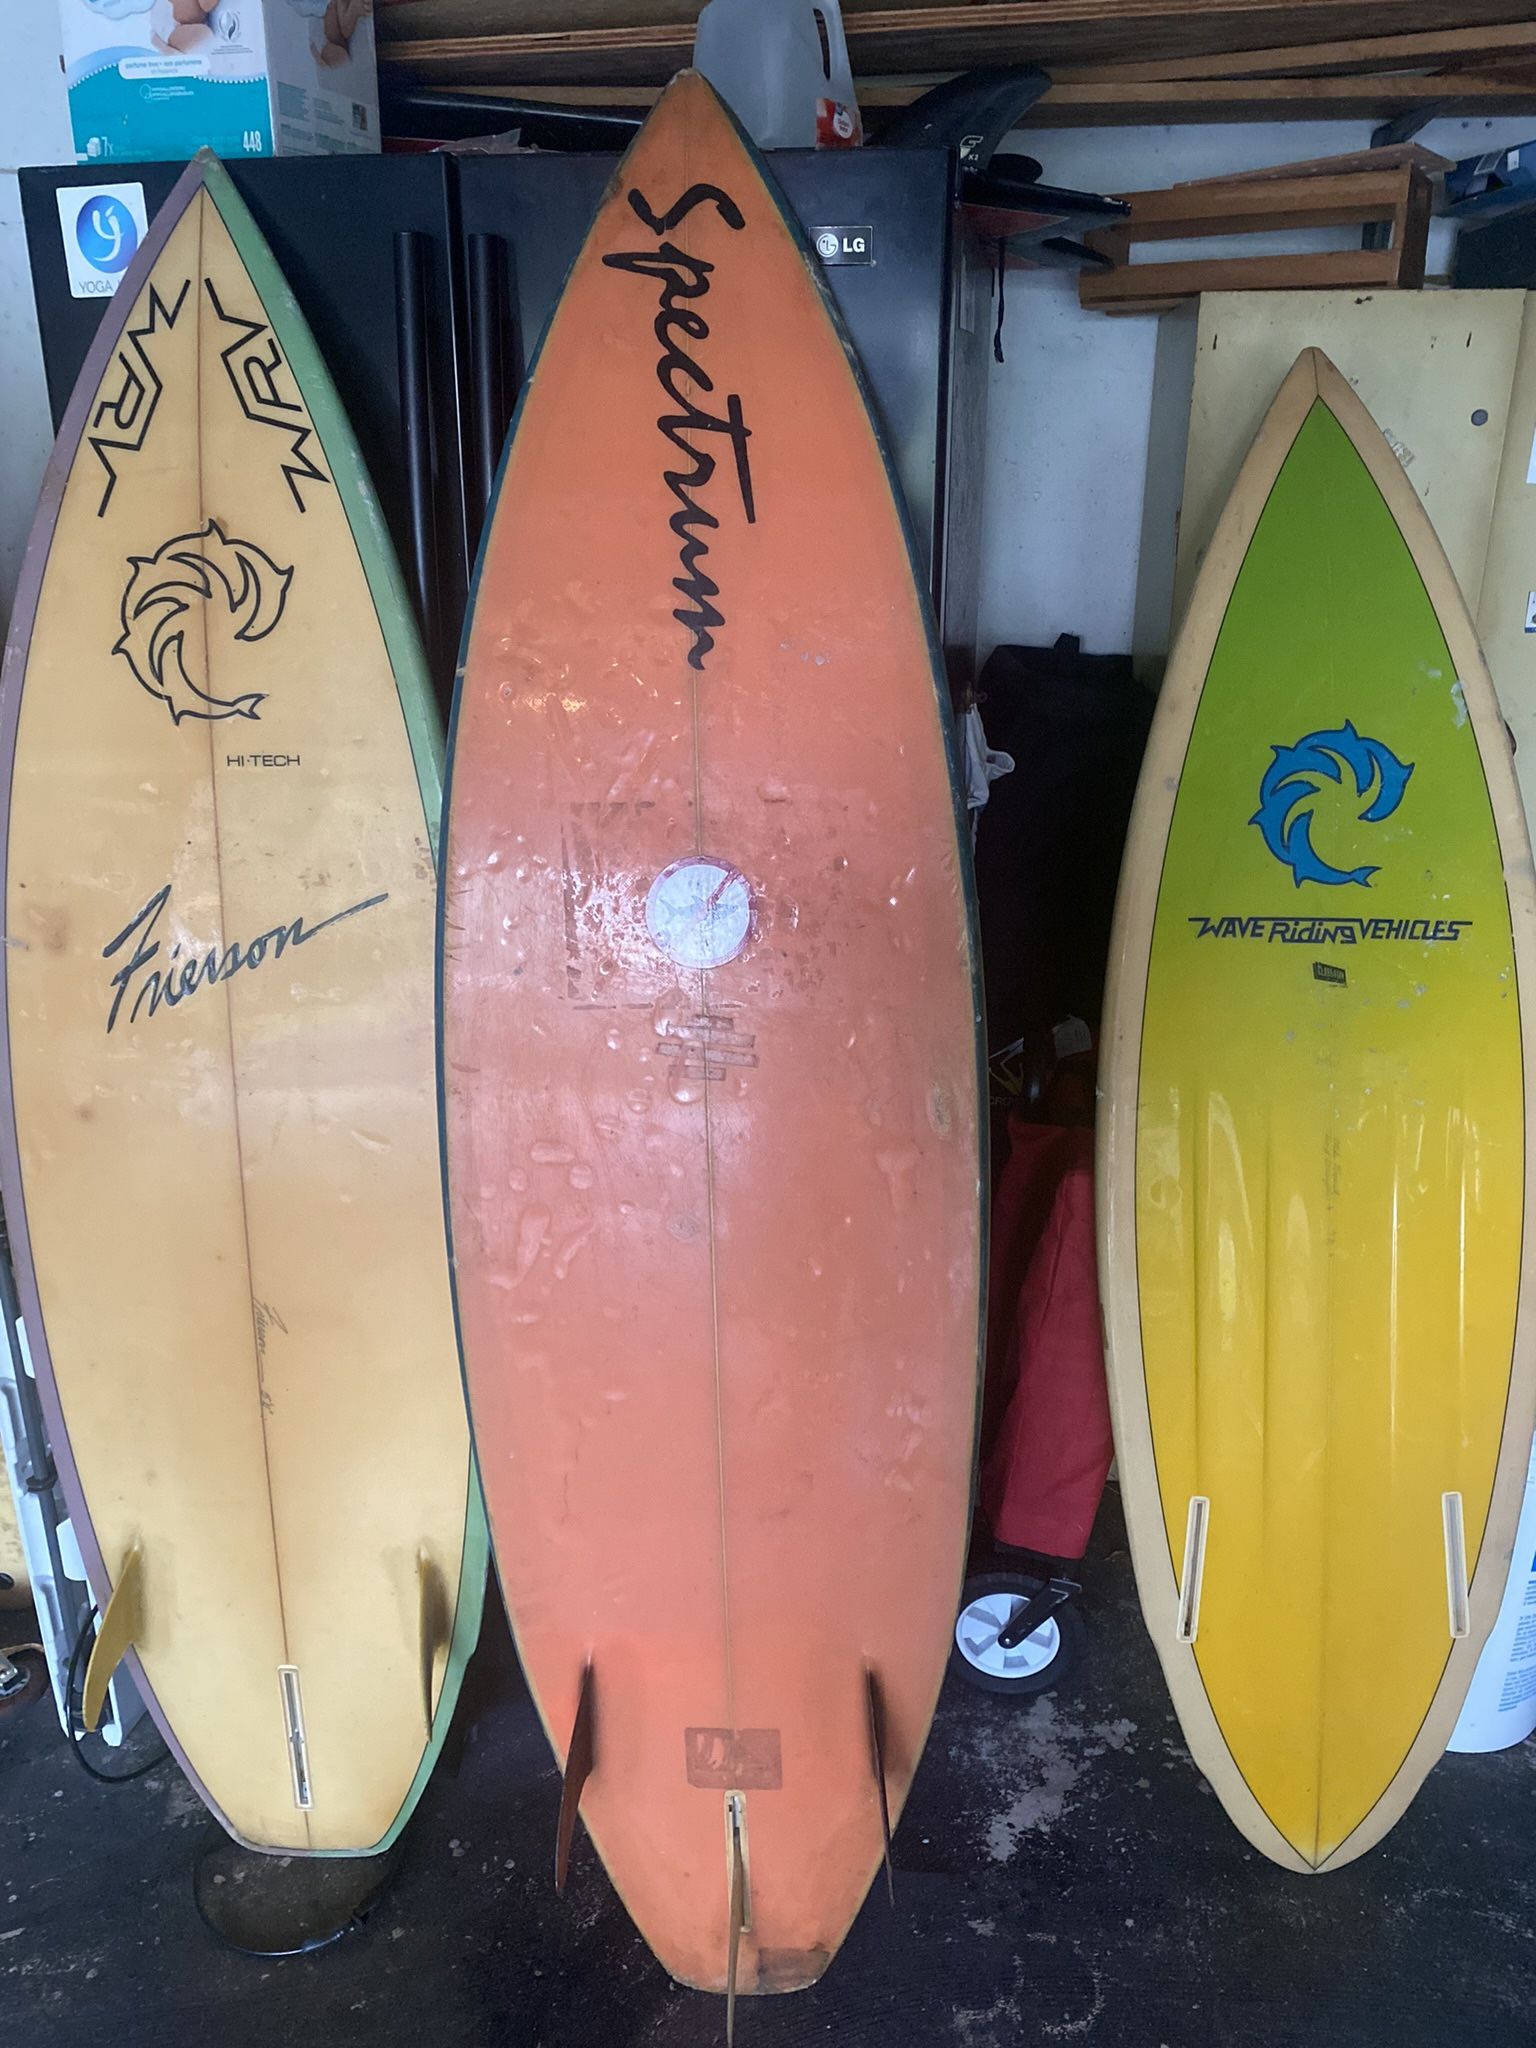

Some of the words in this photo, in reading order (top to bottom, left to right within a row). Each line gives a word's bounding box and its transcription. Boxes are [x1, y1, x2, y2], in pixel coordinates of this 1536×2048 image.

[243, 130, 262, 152] 448
[843, 238, 866, 253] LG
[79, 280, 114, 294] YOGA
[602, 183, 756, 671] Spectrum
[1188, 917, 1265, 939] WAVE
[1359, 918, 1473, 942] VEHICLES
[102, 884, 389, 1034] Frierson
